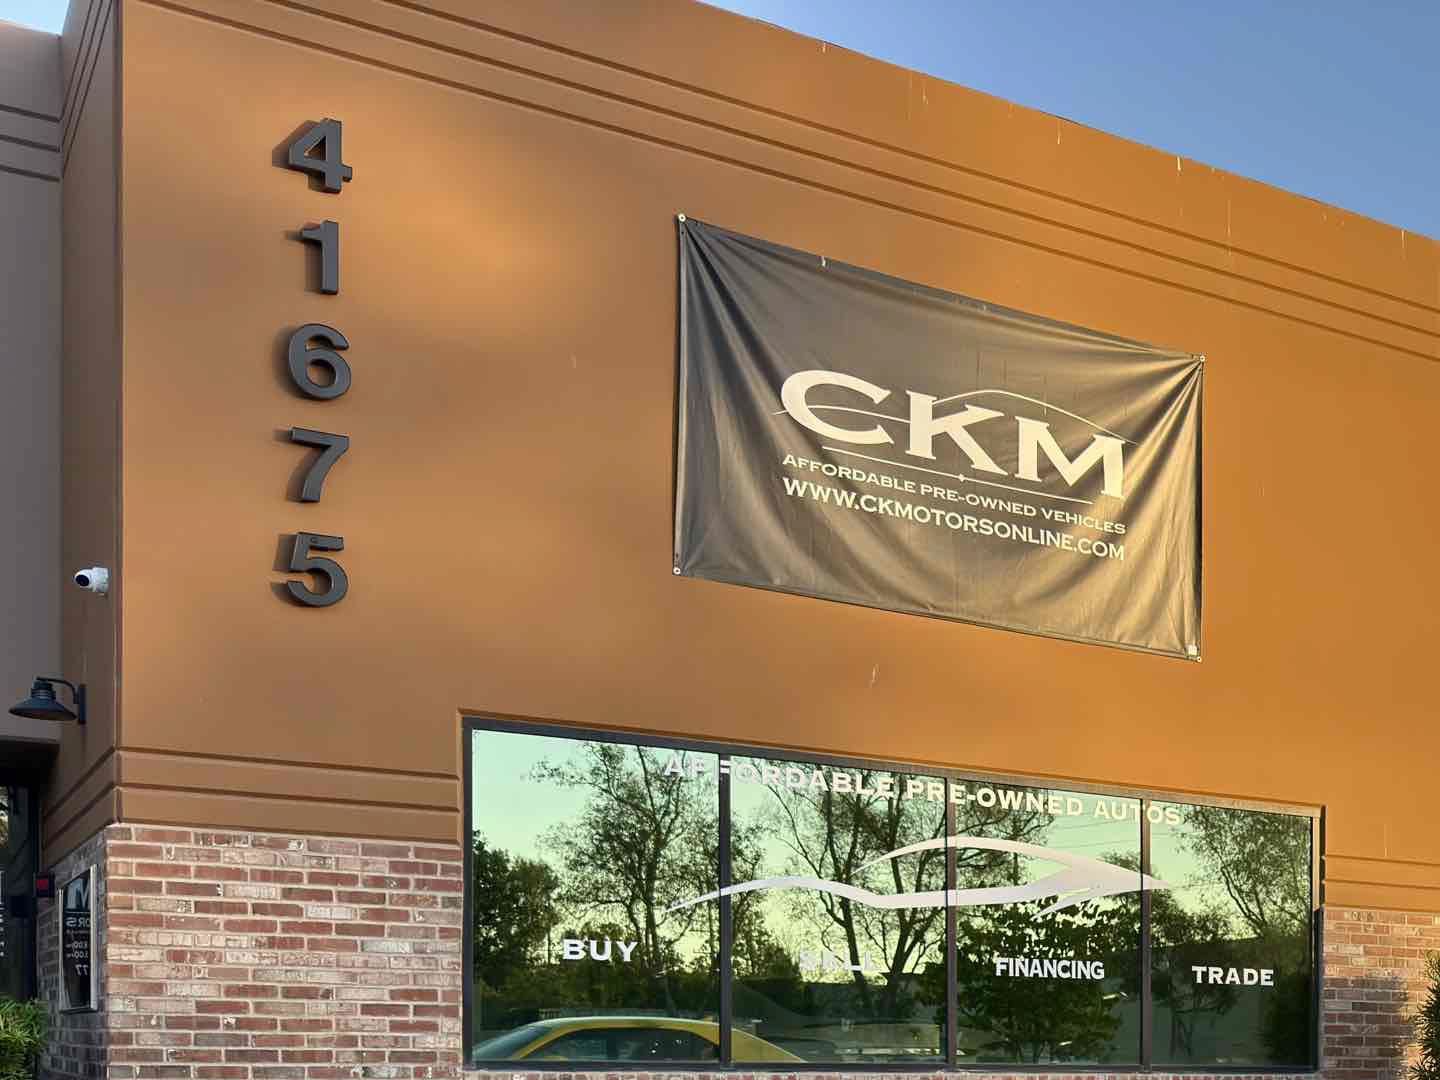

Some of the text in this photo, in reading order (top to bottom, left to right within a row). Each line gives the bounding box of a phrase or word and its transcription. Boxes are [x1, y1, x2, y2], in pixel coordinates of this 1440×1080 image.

[288, 118, 352, 608] 41675
[780, 370, 1126, 499] CKM
[782, 455, 1126, 535] AFFORDABLE PRE-OWNED VEHICLES
[784, 477, 1125, 561] WWW.CKMOTORSONLINE.COM
[663, 754, 1182, 825] AFFORDABLE PRE-OWNED AUTOS
[563, 939, 639, 962] BUY
[995, 957, 1105, 980] FINANCING
[1192, 965, 1274, 987] TRADE
